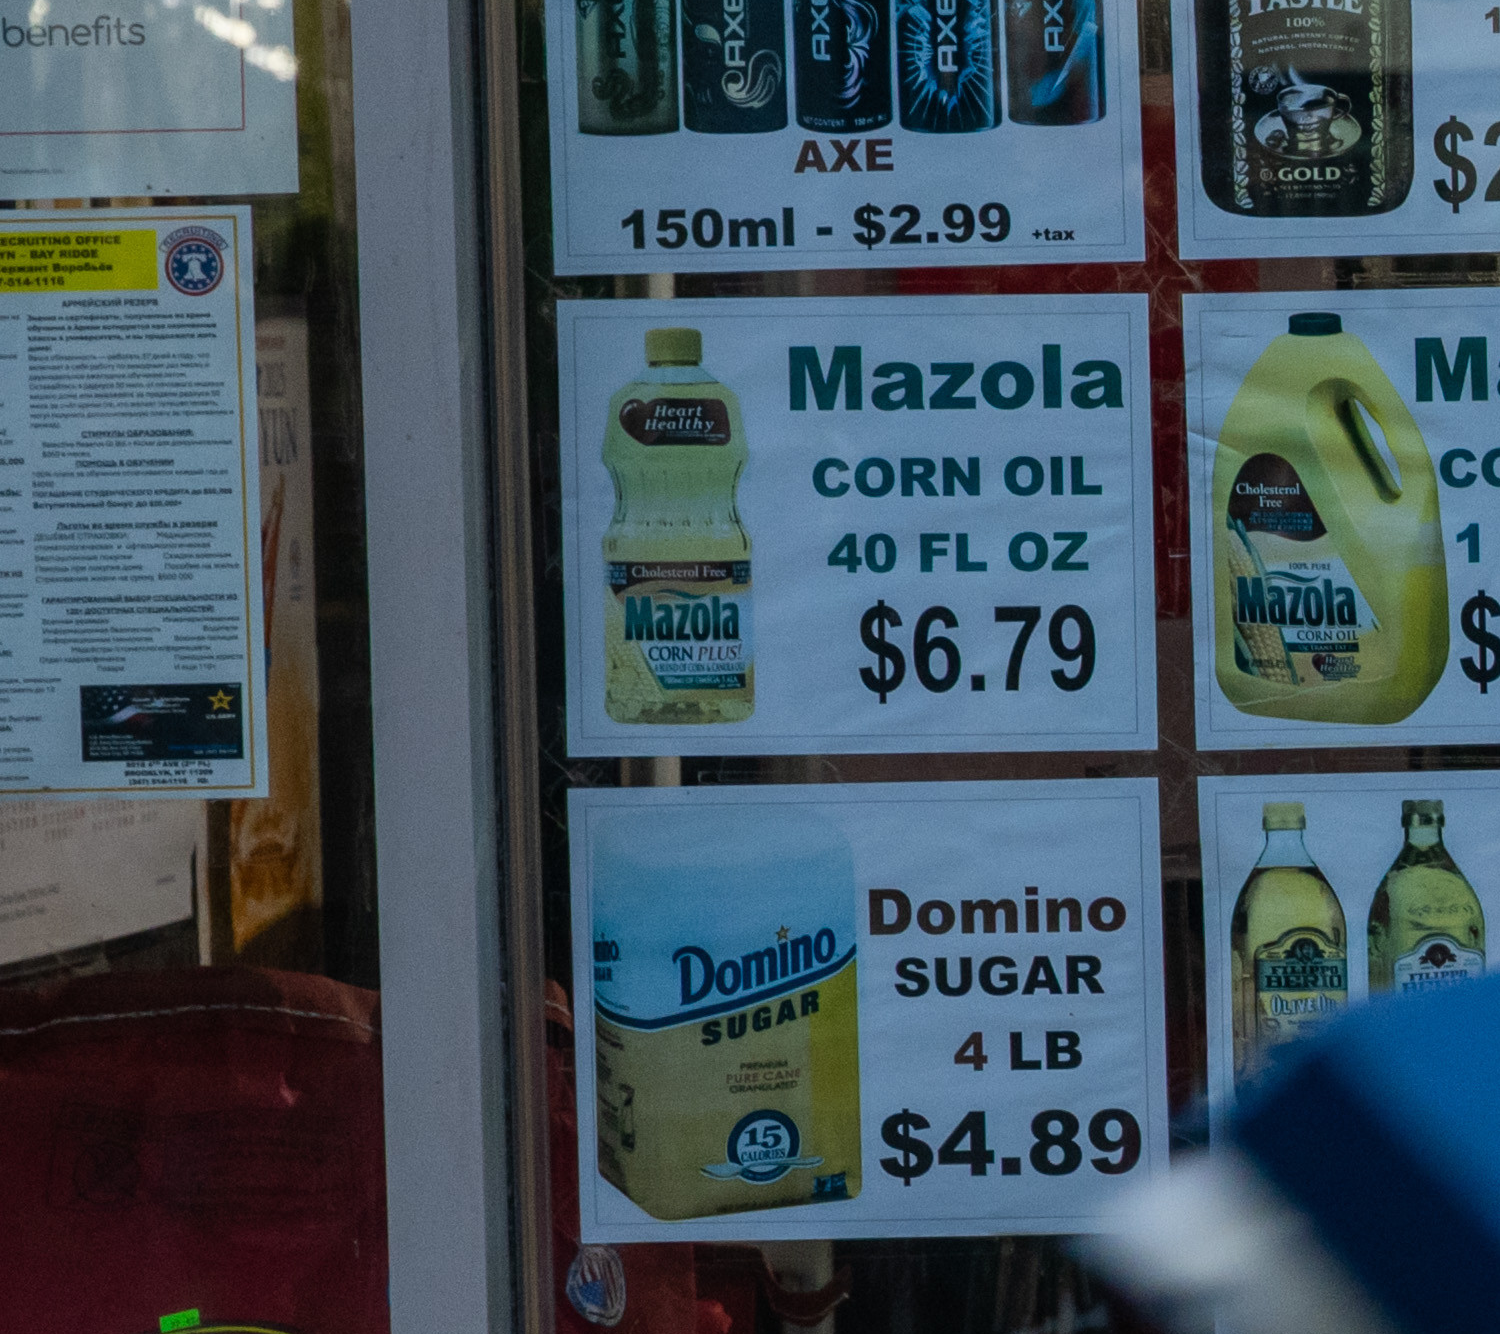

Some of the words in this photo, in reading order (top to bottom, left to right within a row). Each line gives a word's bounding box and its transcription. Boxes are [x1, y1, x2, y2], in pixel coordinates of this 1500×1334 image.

[3, 17, 145, 47] benefits
[794, 139, 895, 173] AXE
[1278, 166, 1341, 182] GOLD
[621, 208, 795, 249] 150ml
[853, 201, 1011, 250] $2.99
[1031, 228, 1075, 241] +tax
[30, 250, 56, 259] BAY
[59, 249, 98, 258] RIDGE
[789, 345, 1124, 411] Mazola
[812, 457, 981, 498] CORN
[1003, 457, 1102, 496] OIL
[827, 533, 897, 574] 40
[920, 533, 987, 572] FL
[1008, 532, 1089, 571] OZ
[1457, 524, 1481, 563] 1
[631, 566, 698, 580] Cholesterol
[703, 566, 728, 579] Free
[624, 596, 739, 642] Mazola
[859, 600, 1097, 704] $6.79
[869, 887, 1127, 936] Domino
[894, 955, 1105, 998] SUGAR
[954, 1032, 988, 1071] 4
[1009, 1031, 1082, 1070] LB
[741, 1148, 787, 1162] CALORIES
[744, 1127, 782, 1148] 15
[880, 1108, 1142, 1187] $4.89
